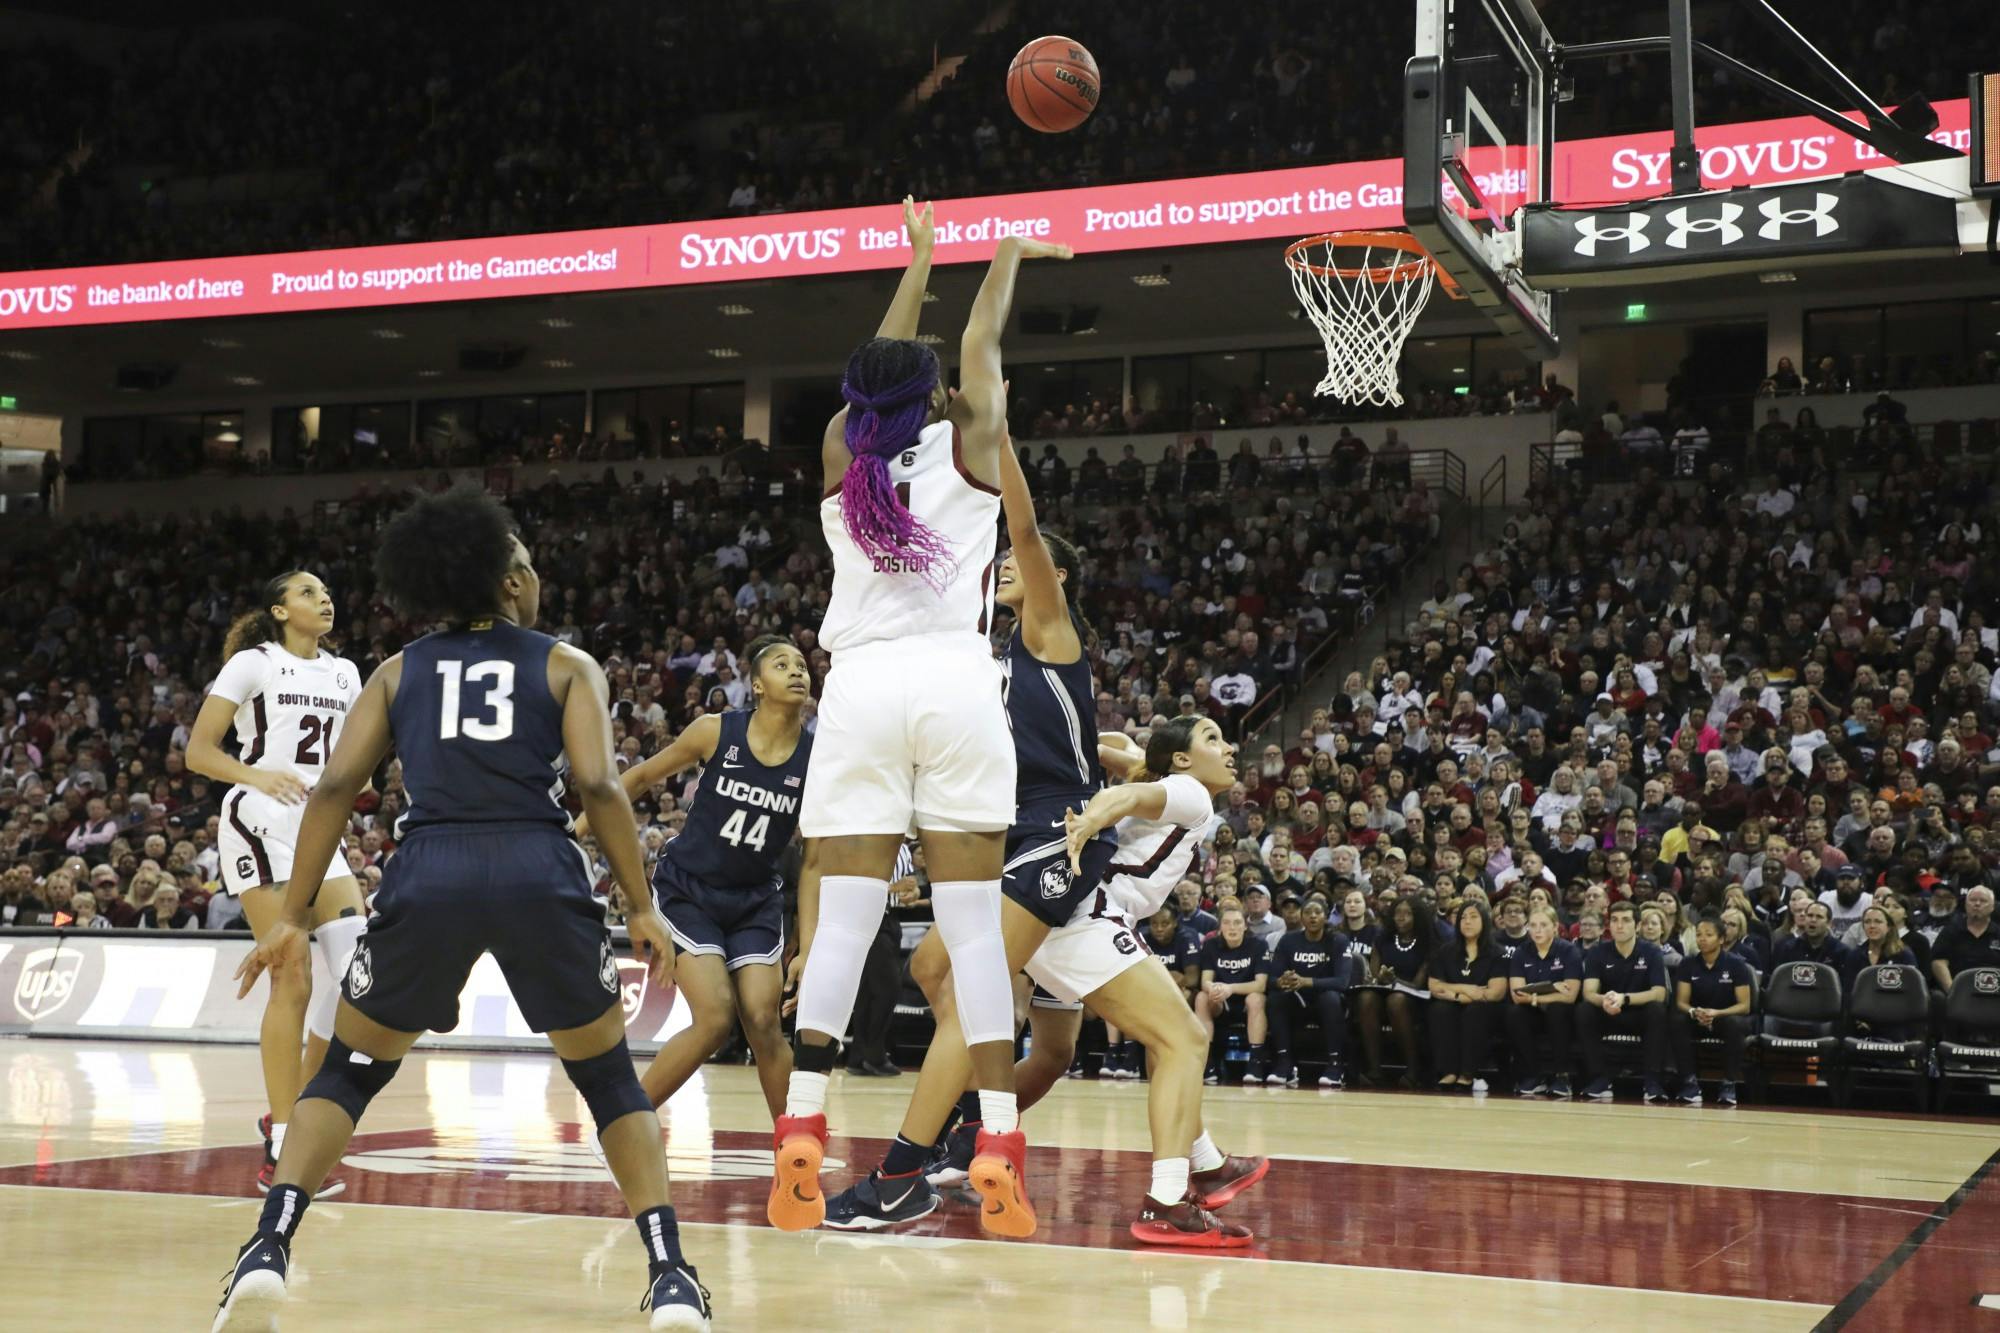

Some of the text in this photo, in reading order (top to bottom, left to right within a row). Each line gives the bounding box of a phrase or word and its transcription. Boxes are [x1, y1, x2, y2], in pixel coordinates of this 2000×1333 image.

[1612, 137, 1828, 188] SYOVUS
[1085, 203, 1163, 232] Proud
[1168, 200, 1194, 224] to
[1199, 191, 1302, 224] support
[1307, 187, 1353, 212] the
[680, 228, 842, 268] SYNOVUS
[859, 228, 898, 250] the
[965, 218, 992, 241] of
[994, 217, 1051, 240] here
[87, 285, 119, 306] the
[122, 280, 172, 304] bank
[175, 278, 195, 301] of
[198, 277, 244, 299] here
[272, 248, 617, 294] Proud to support the Gamecocks!
[278, 693, 347, 713] SOUTH CAROLIN
[436, 660, 516, 742] 13
[295, 714, 335, 766] 21
[715, 775, 798, 815] UCONN
[719, 808, 771, 852] 44
[1217, 957, 1251, 970] UCONN
[20, 970, 73, 1009] ups
